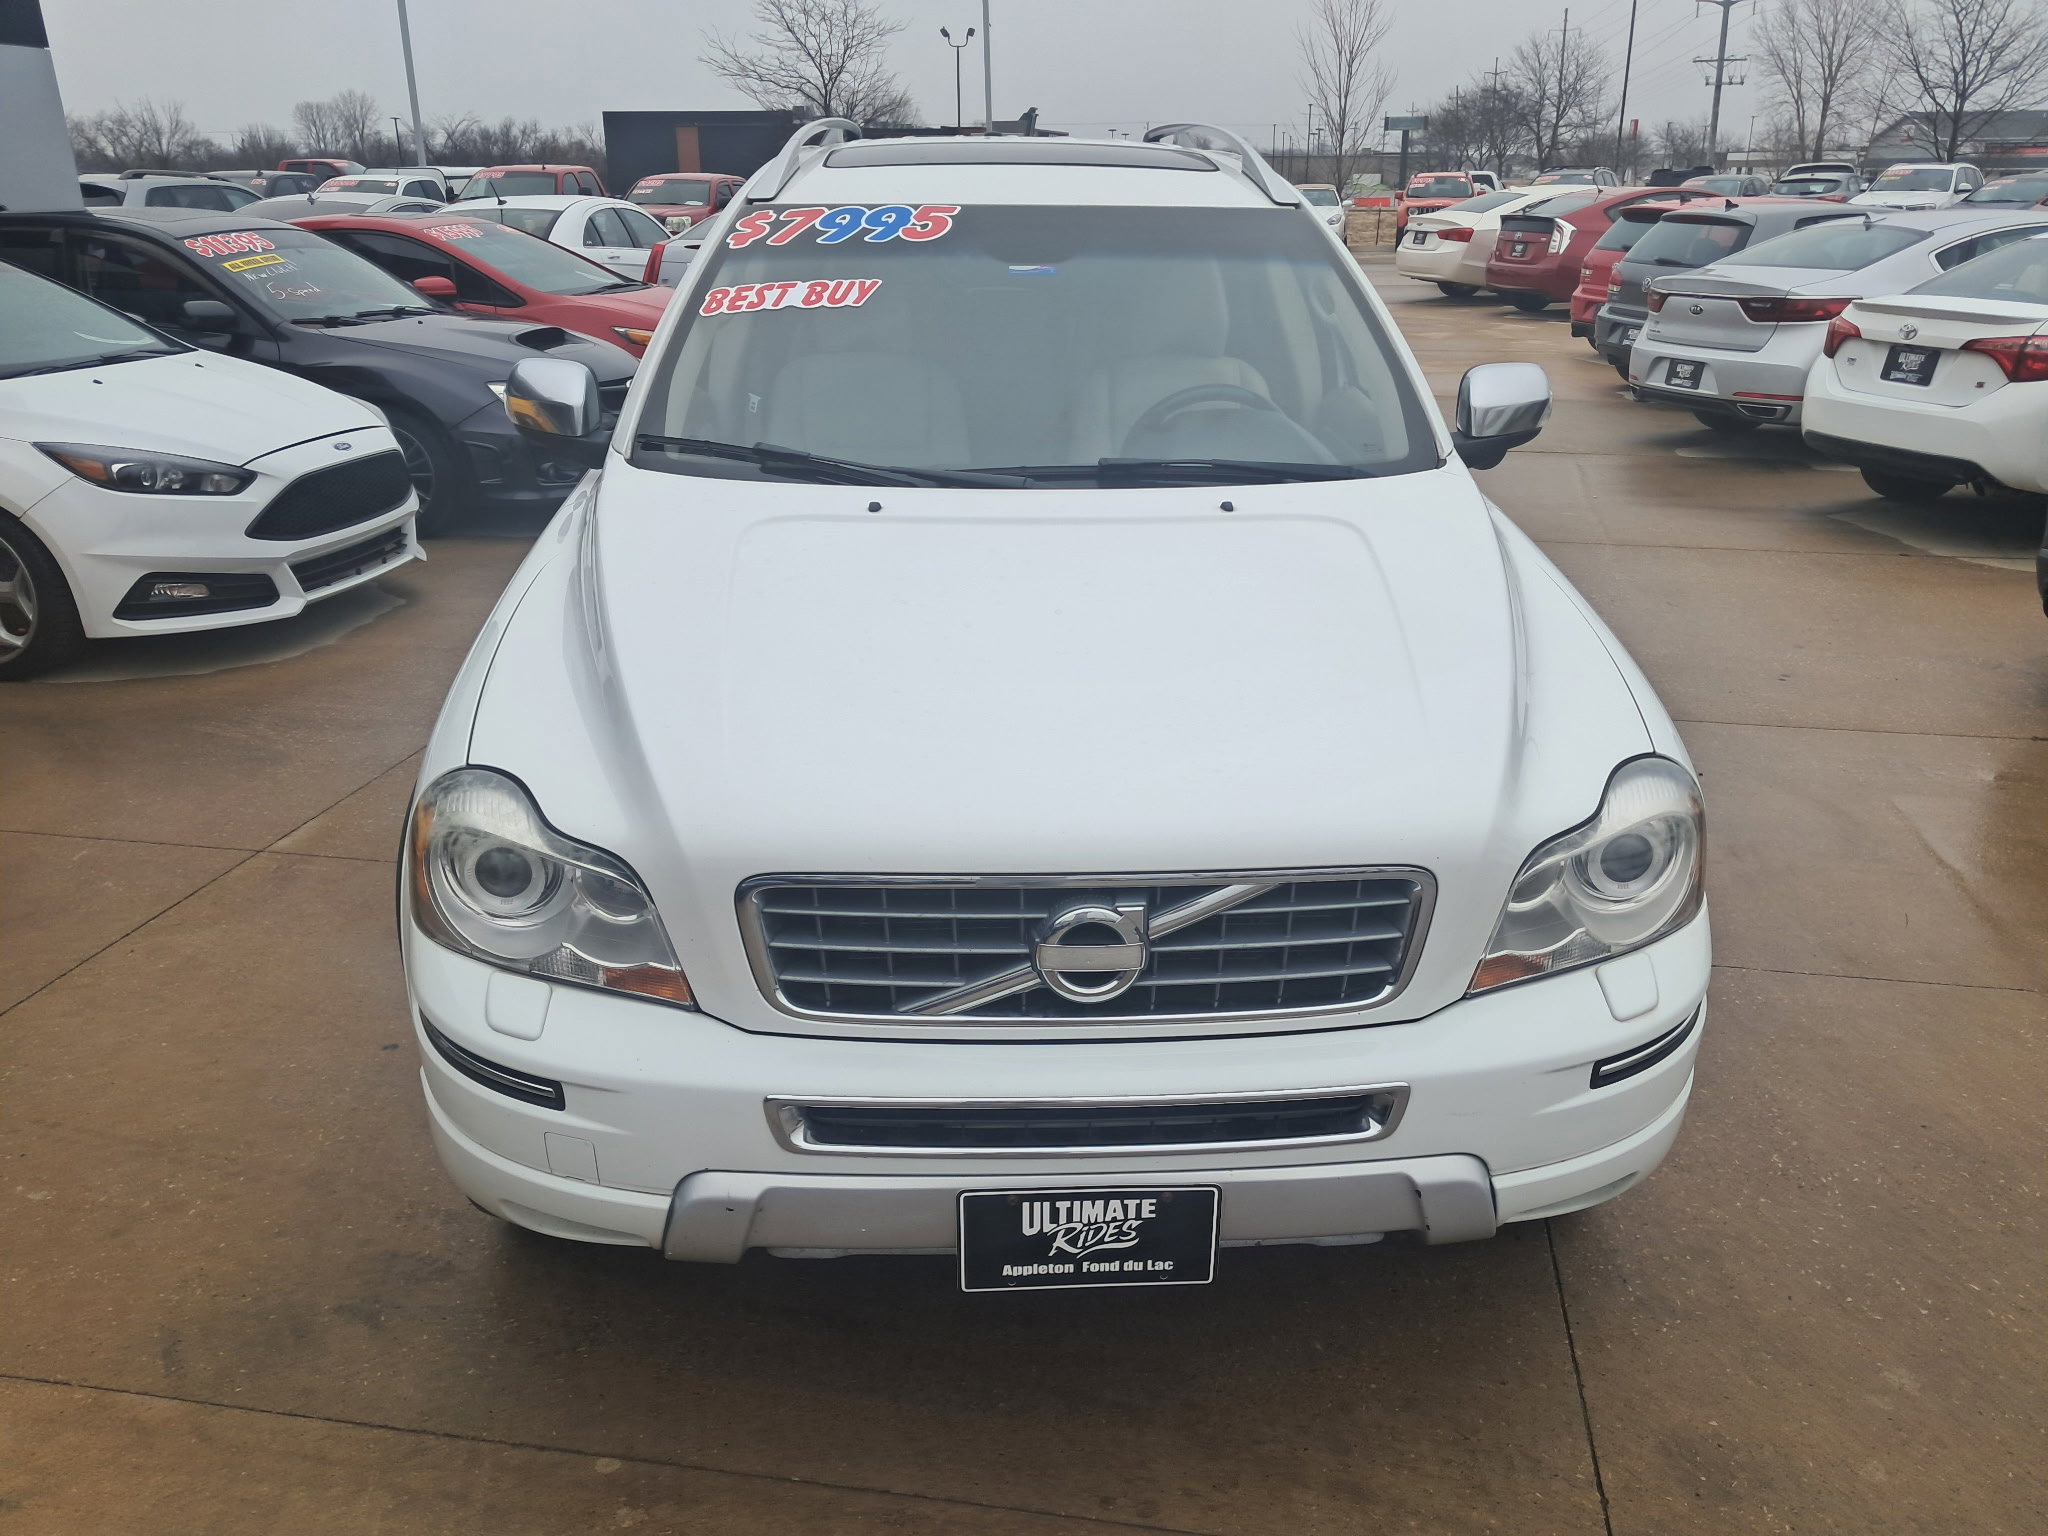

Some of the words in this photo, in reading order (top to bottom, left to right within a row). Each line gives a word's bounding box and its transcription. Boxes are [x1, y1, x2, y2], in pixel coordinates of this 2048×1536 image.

[184, 232, 275, 257] $11395
[727, 204, 961, 249] $7995
[699, 282, 799, 317] BEST
[801, 278, 882, 308] BUY
[1021, 1198, 1157, 1237] ULTIMATE
[1002, 1262, 1074, 1277] Appleton
[1082, 1260, 1120, 1273] Fond
[1123, 1260, 1143, 1272] du
[1147, 1259, 1174, 1271] Lac
